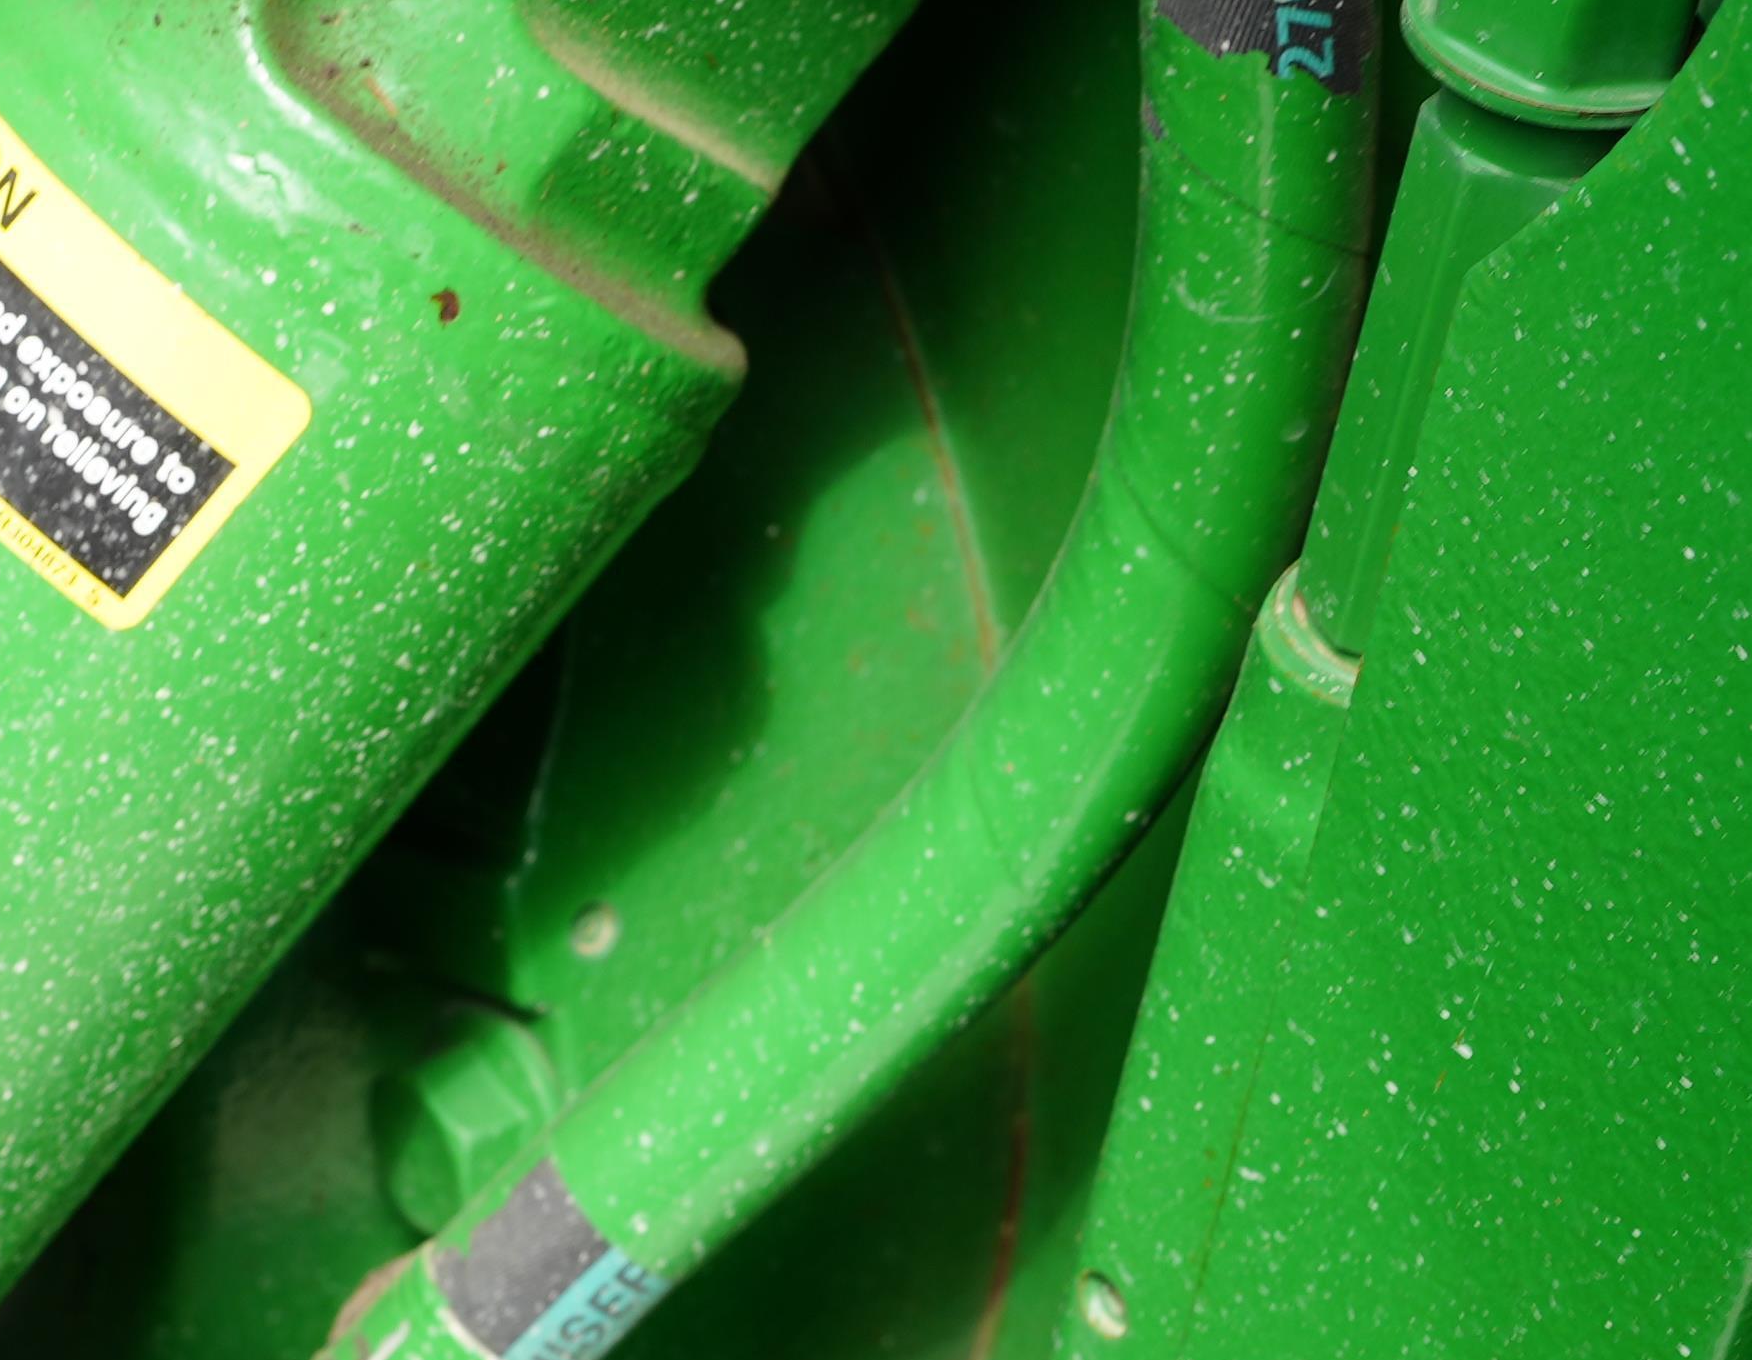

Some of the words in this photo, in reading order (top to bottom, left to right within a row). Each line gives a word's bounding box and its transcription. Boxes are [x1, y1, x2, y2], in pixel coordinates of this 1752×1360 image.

[2, 384, 47, 432] on
[40, 422, 168, 536] relieving
[16, 335, 159, 465] exposure
[155, 451, 196, 495] to
